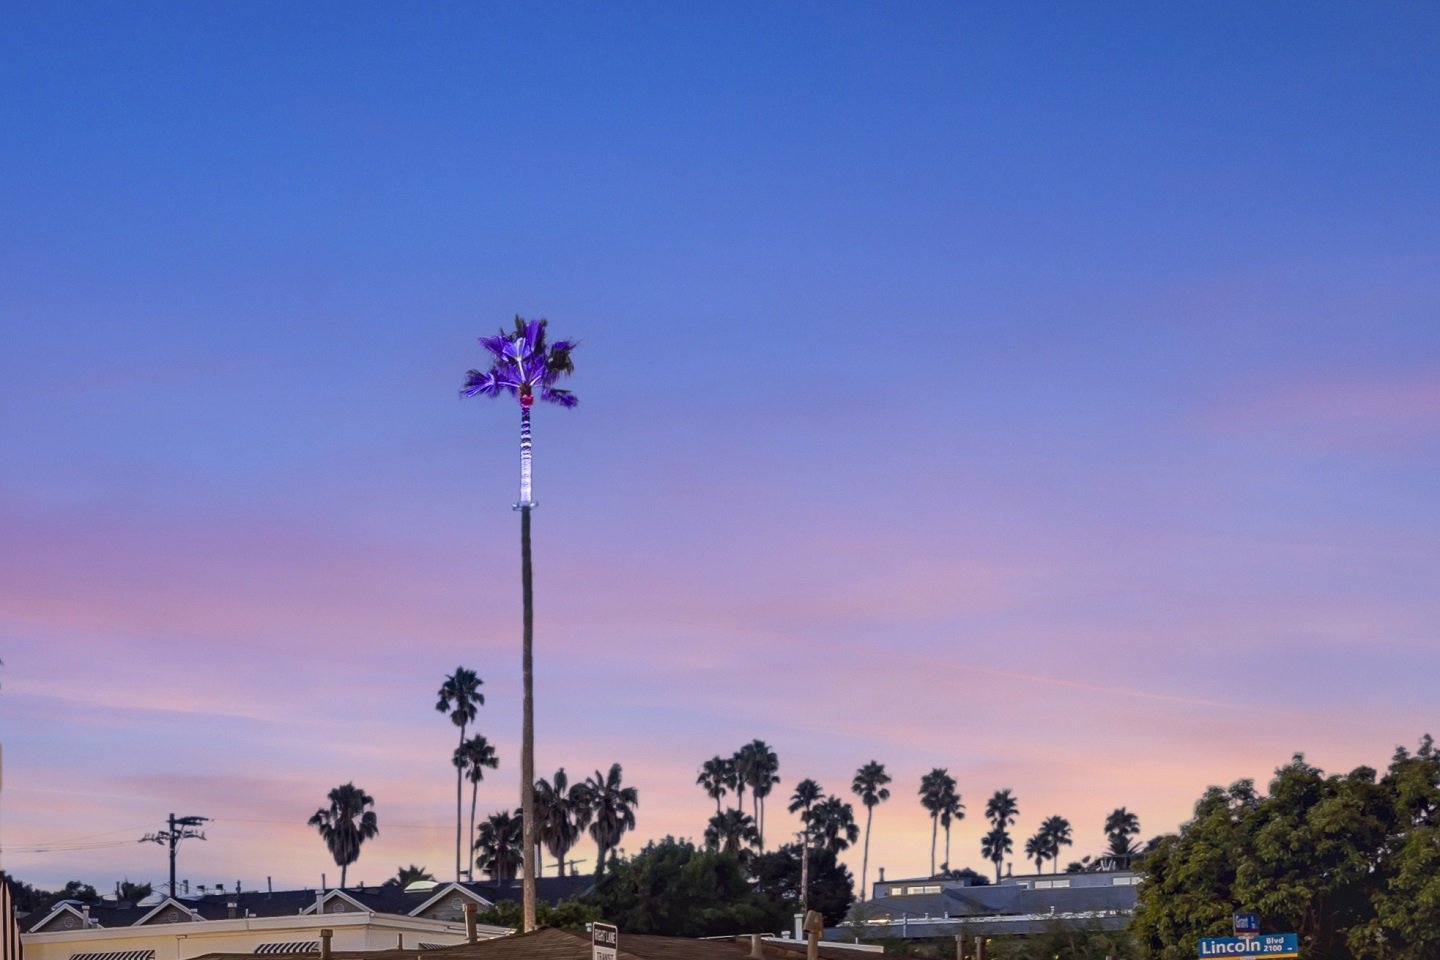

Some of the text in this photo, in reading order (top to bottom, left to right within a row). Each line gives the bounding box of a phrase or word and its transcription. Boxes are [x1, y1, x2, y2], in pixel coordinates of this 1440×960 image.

[606, 931, 616, 944] LANE
[1202, 937, 1284, 954] Lincoln Blvd
